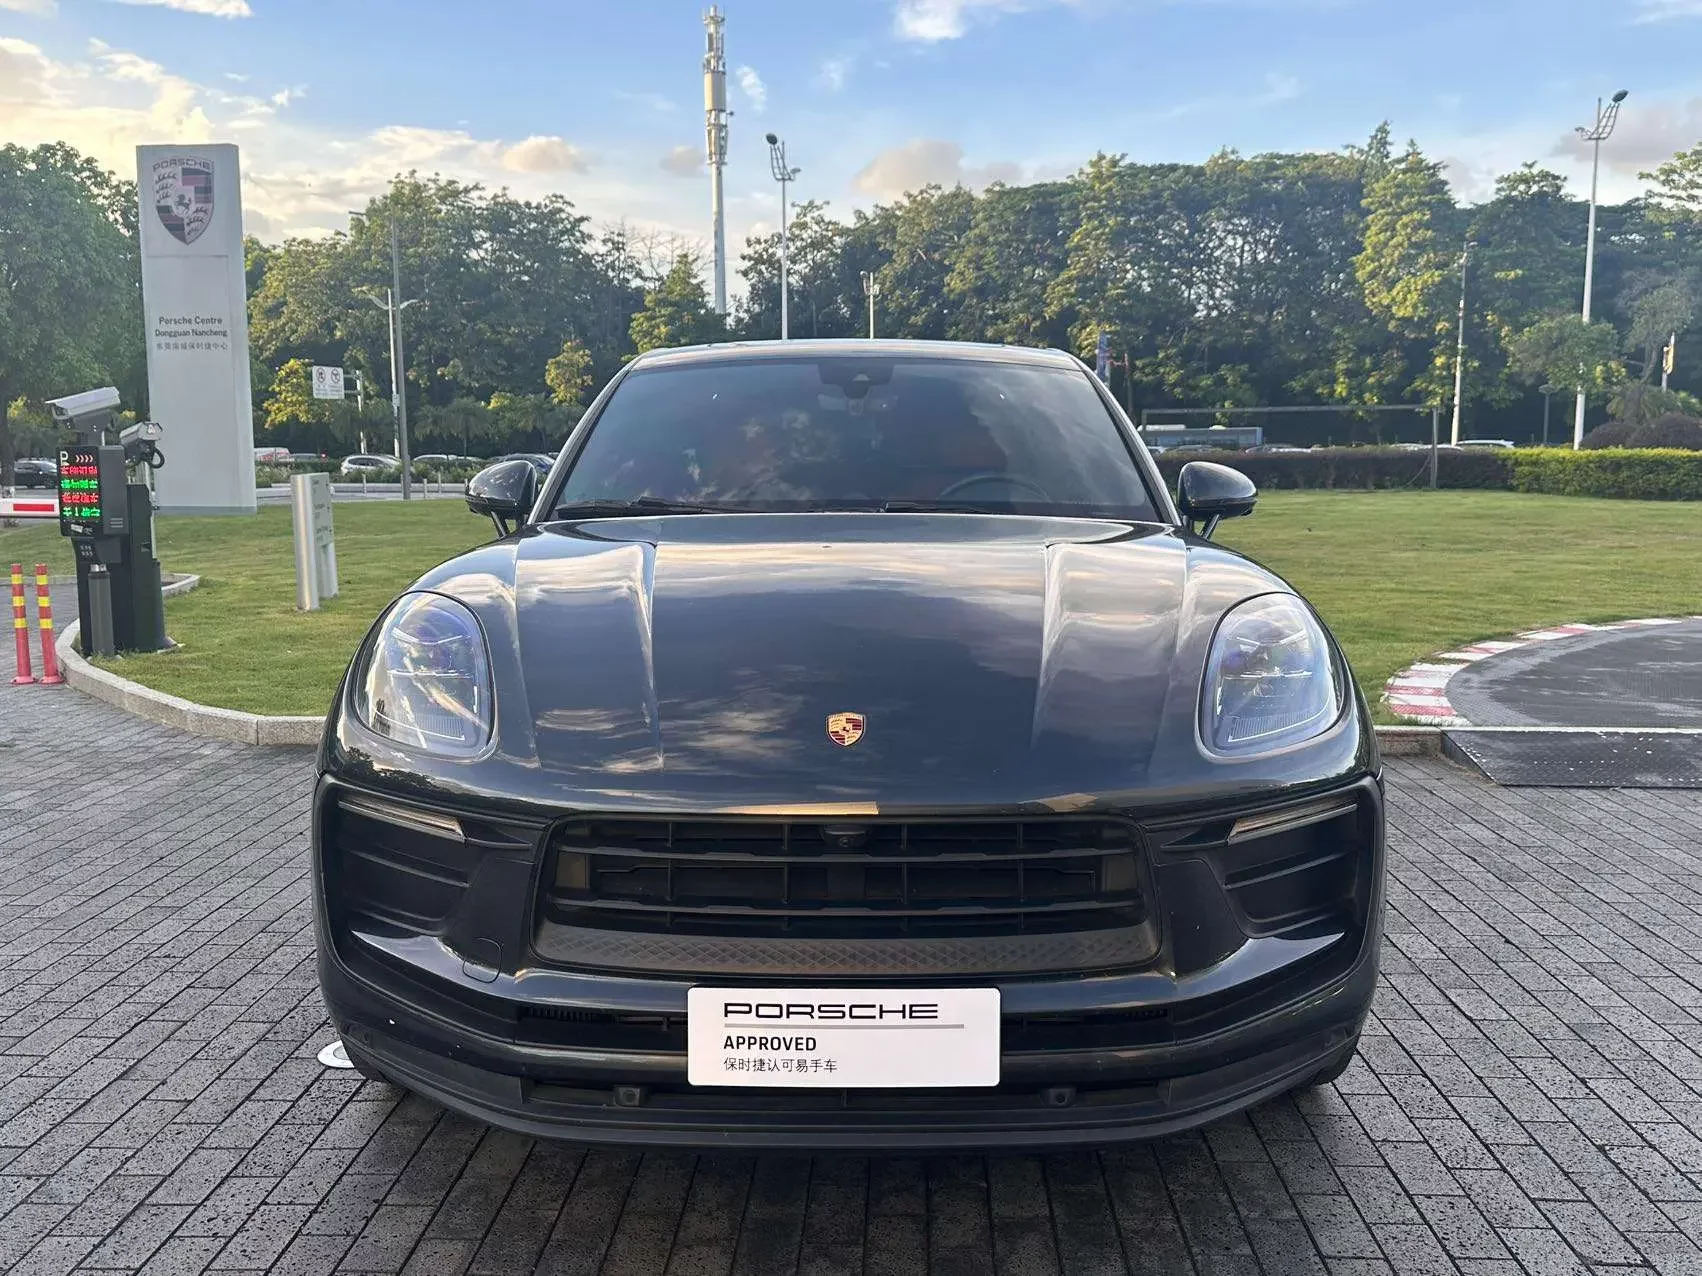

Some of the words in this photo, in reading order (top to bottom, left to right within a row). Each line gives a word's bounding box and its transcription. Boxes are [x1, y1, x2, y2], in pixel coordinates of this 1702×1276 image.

[159, 316, 192, 325] Porsche
[194, 316, 223, 325] Centre
[155, 329, 190, 338] Dongguan
[724, 1002, 938, 1019] PORSCHE
[723, 1035, 817, 1052] APPROVED
[723, 1056, 838, 1073] 保时捷认可易手车
